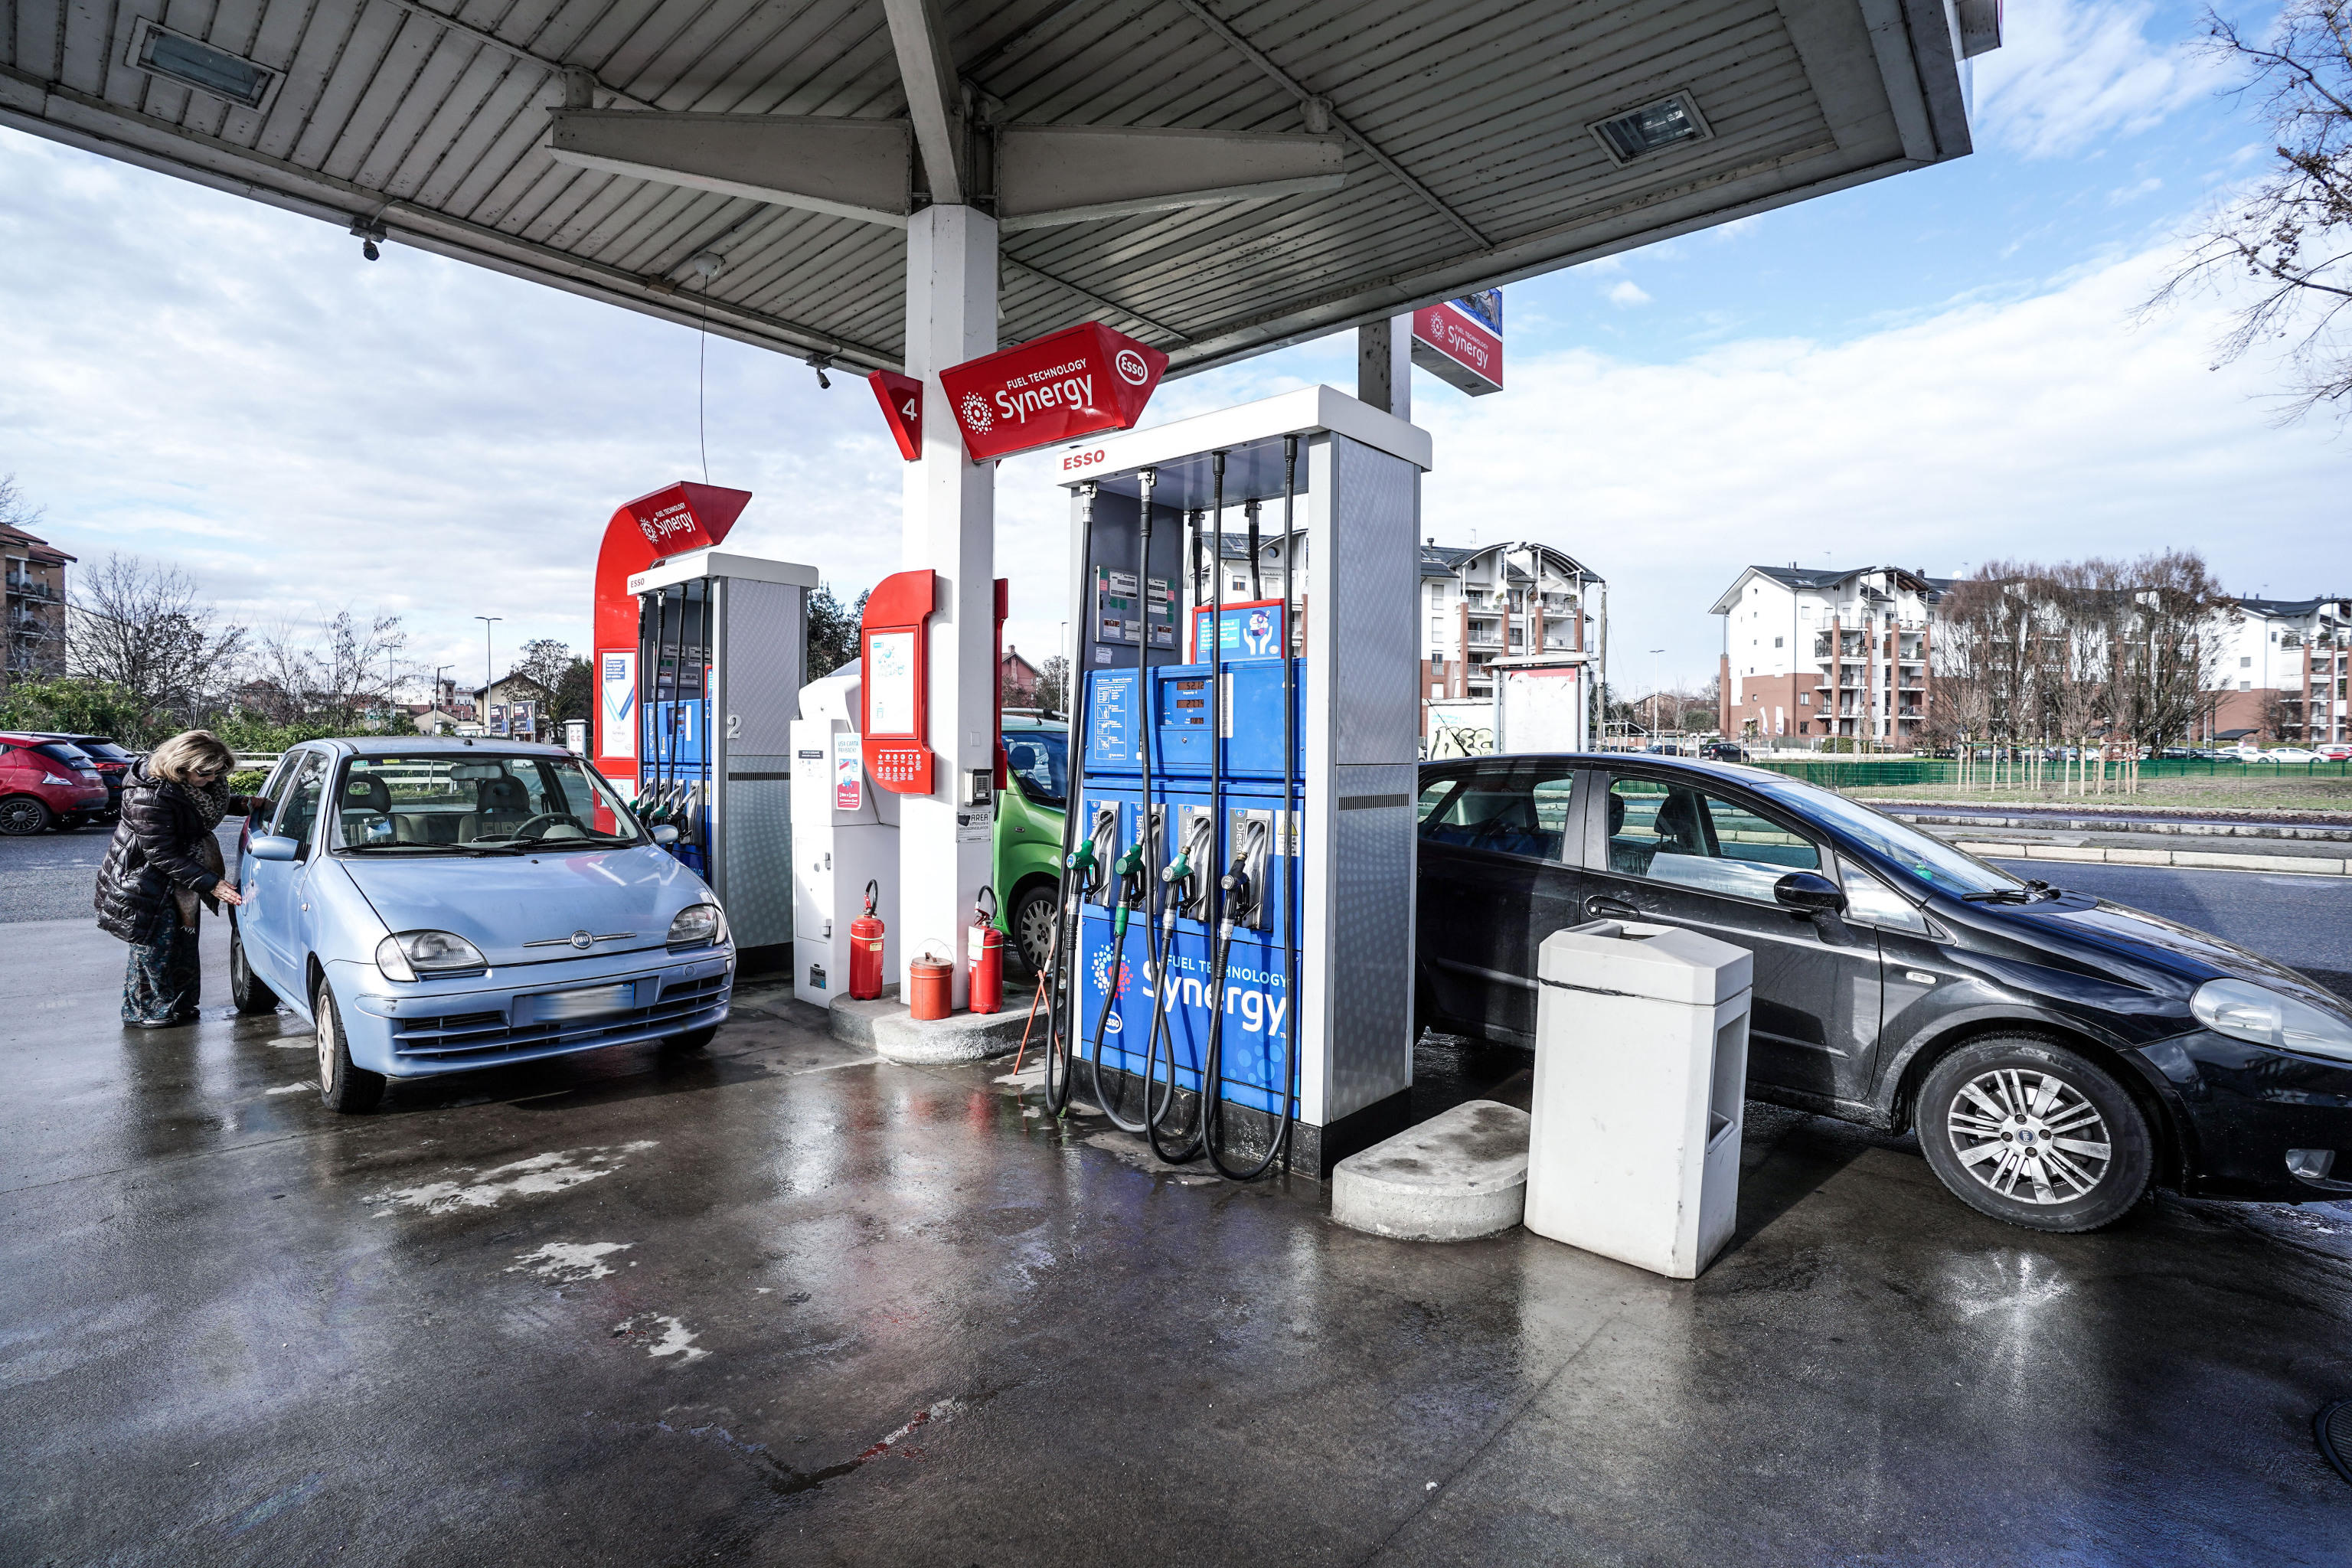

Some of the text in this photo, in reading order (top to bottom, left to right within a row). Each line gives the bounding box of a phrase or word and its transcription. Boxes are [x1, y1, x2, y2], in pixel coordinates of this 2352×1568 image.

[1448, 325, 1488, 369] Synergy
[1455, 325, 1488, 350] FUEL TECHNOLOGY
[1006, 358, 1087, 390] FUEL TECHNOLOGY
[902, 397, 917, 421] 4
[995, 374, 1093, 423] Synergy
[1063, 449, 1106, 471] ESSO
[664, 502, 687, 515] TECHNOLOGY
[653, 511, 696, 539] Synergy
[631, 577, 645, 588] ESSO
[706, 706, 711, 719] 2
[727, 714, 743, 740] 2
[1167, 954, 1287, 987] FUEL TEHNOLOGY
